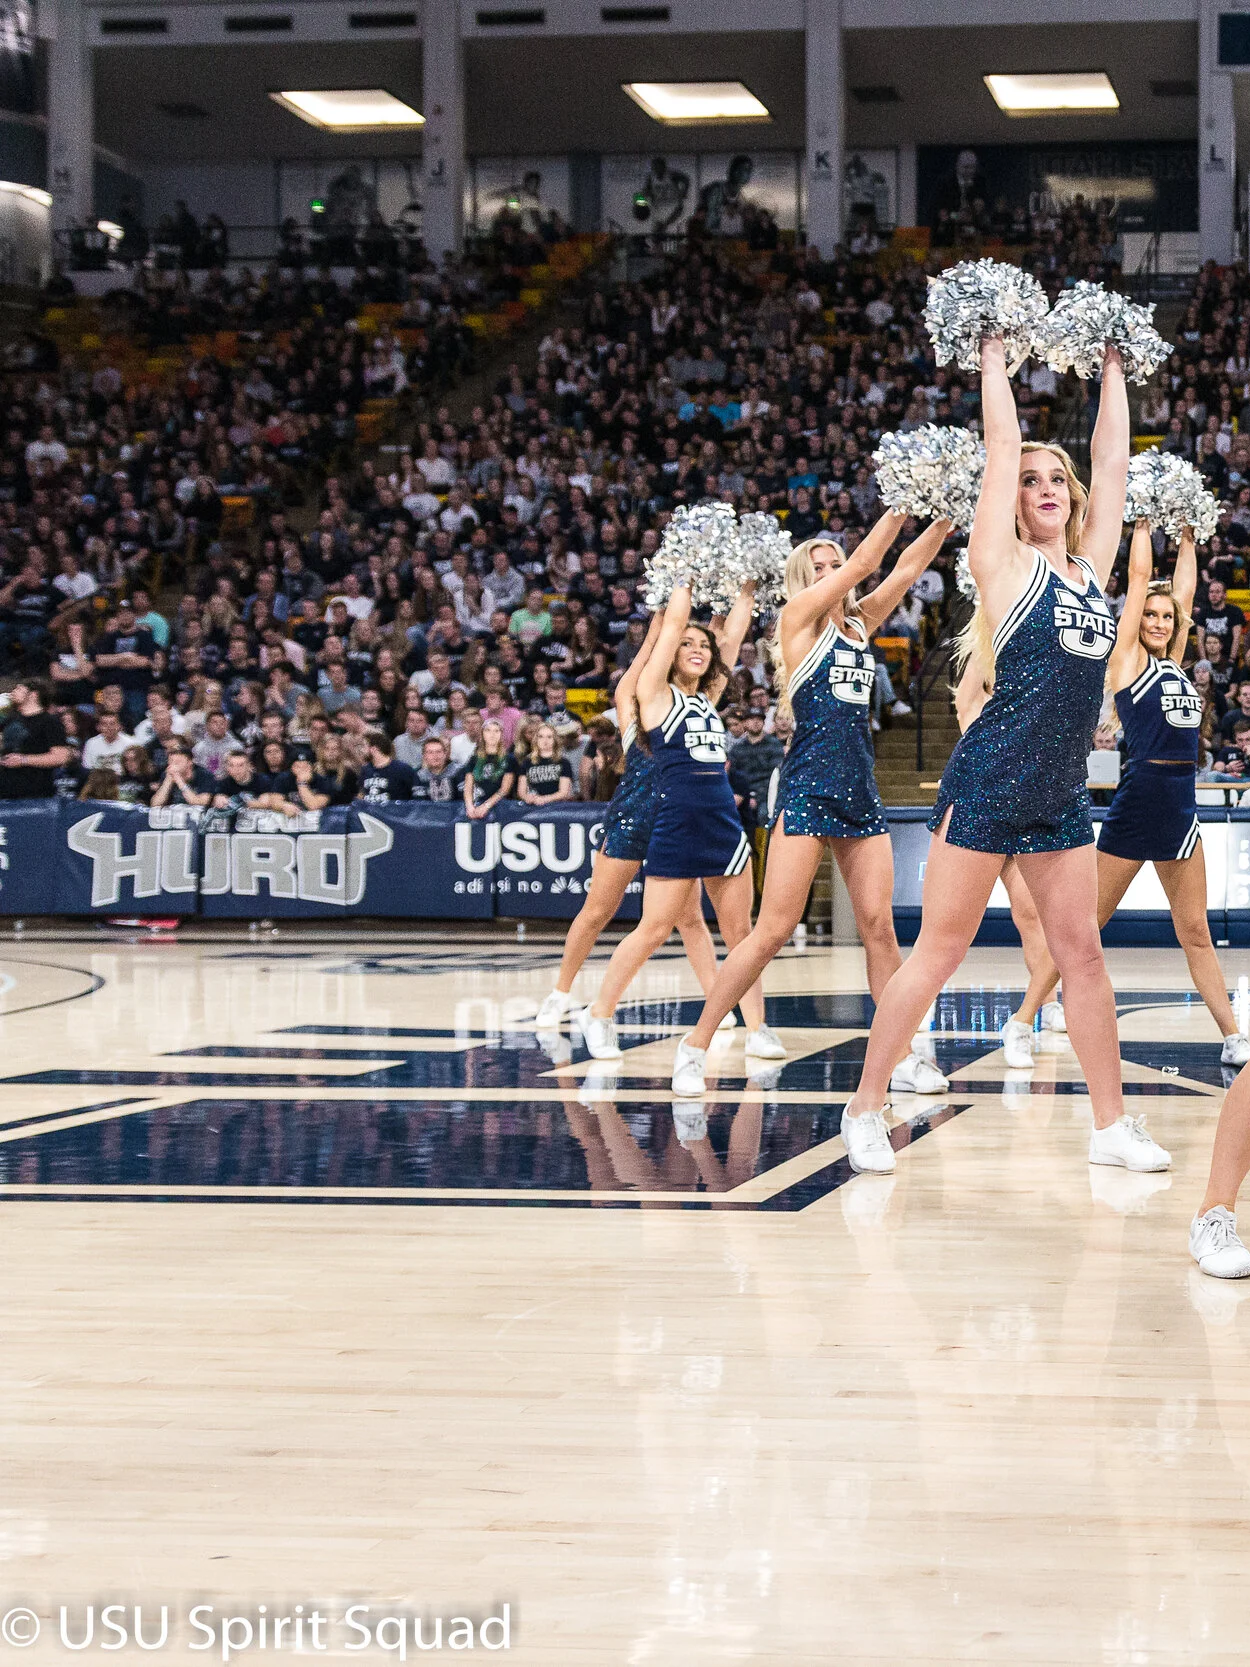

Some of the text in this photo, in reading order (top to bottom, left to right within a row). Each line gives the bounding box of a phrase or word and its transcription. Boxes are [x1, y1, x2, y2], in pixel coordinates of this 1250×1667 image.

[815, 151, 829, 168] K
[1210, 144, 1223, 161] L
[431, 159, 444, 177] J
[1053, 605, 1117, 640] STATE
[1160, 695, 1202, 711] STATE
[454, 822, 586, 873] USU
[68, 812, 393, 907] HURD
